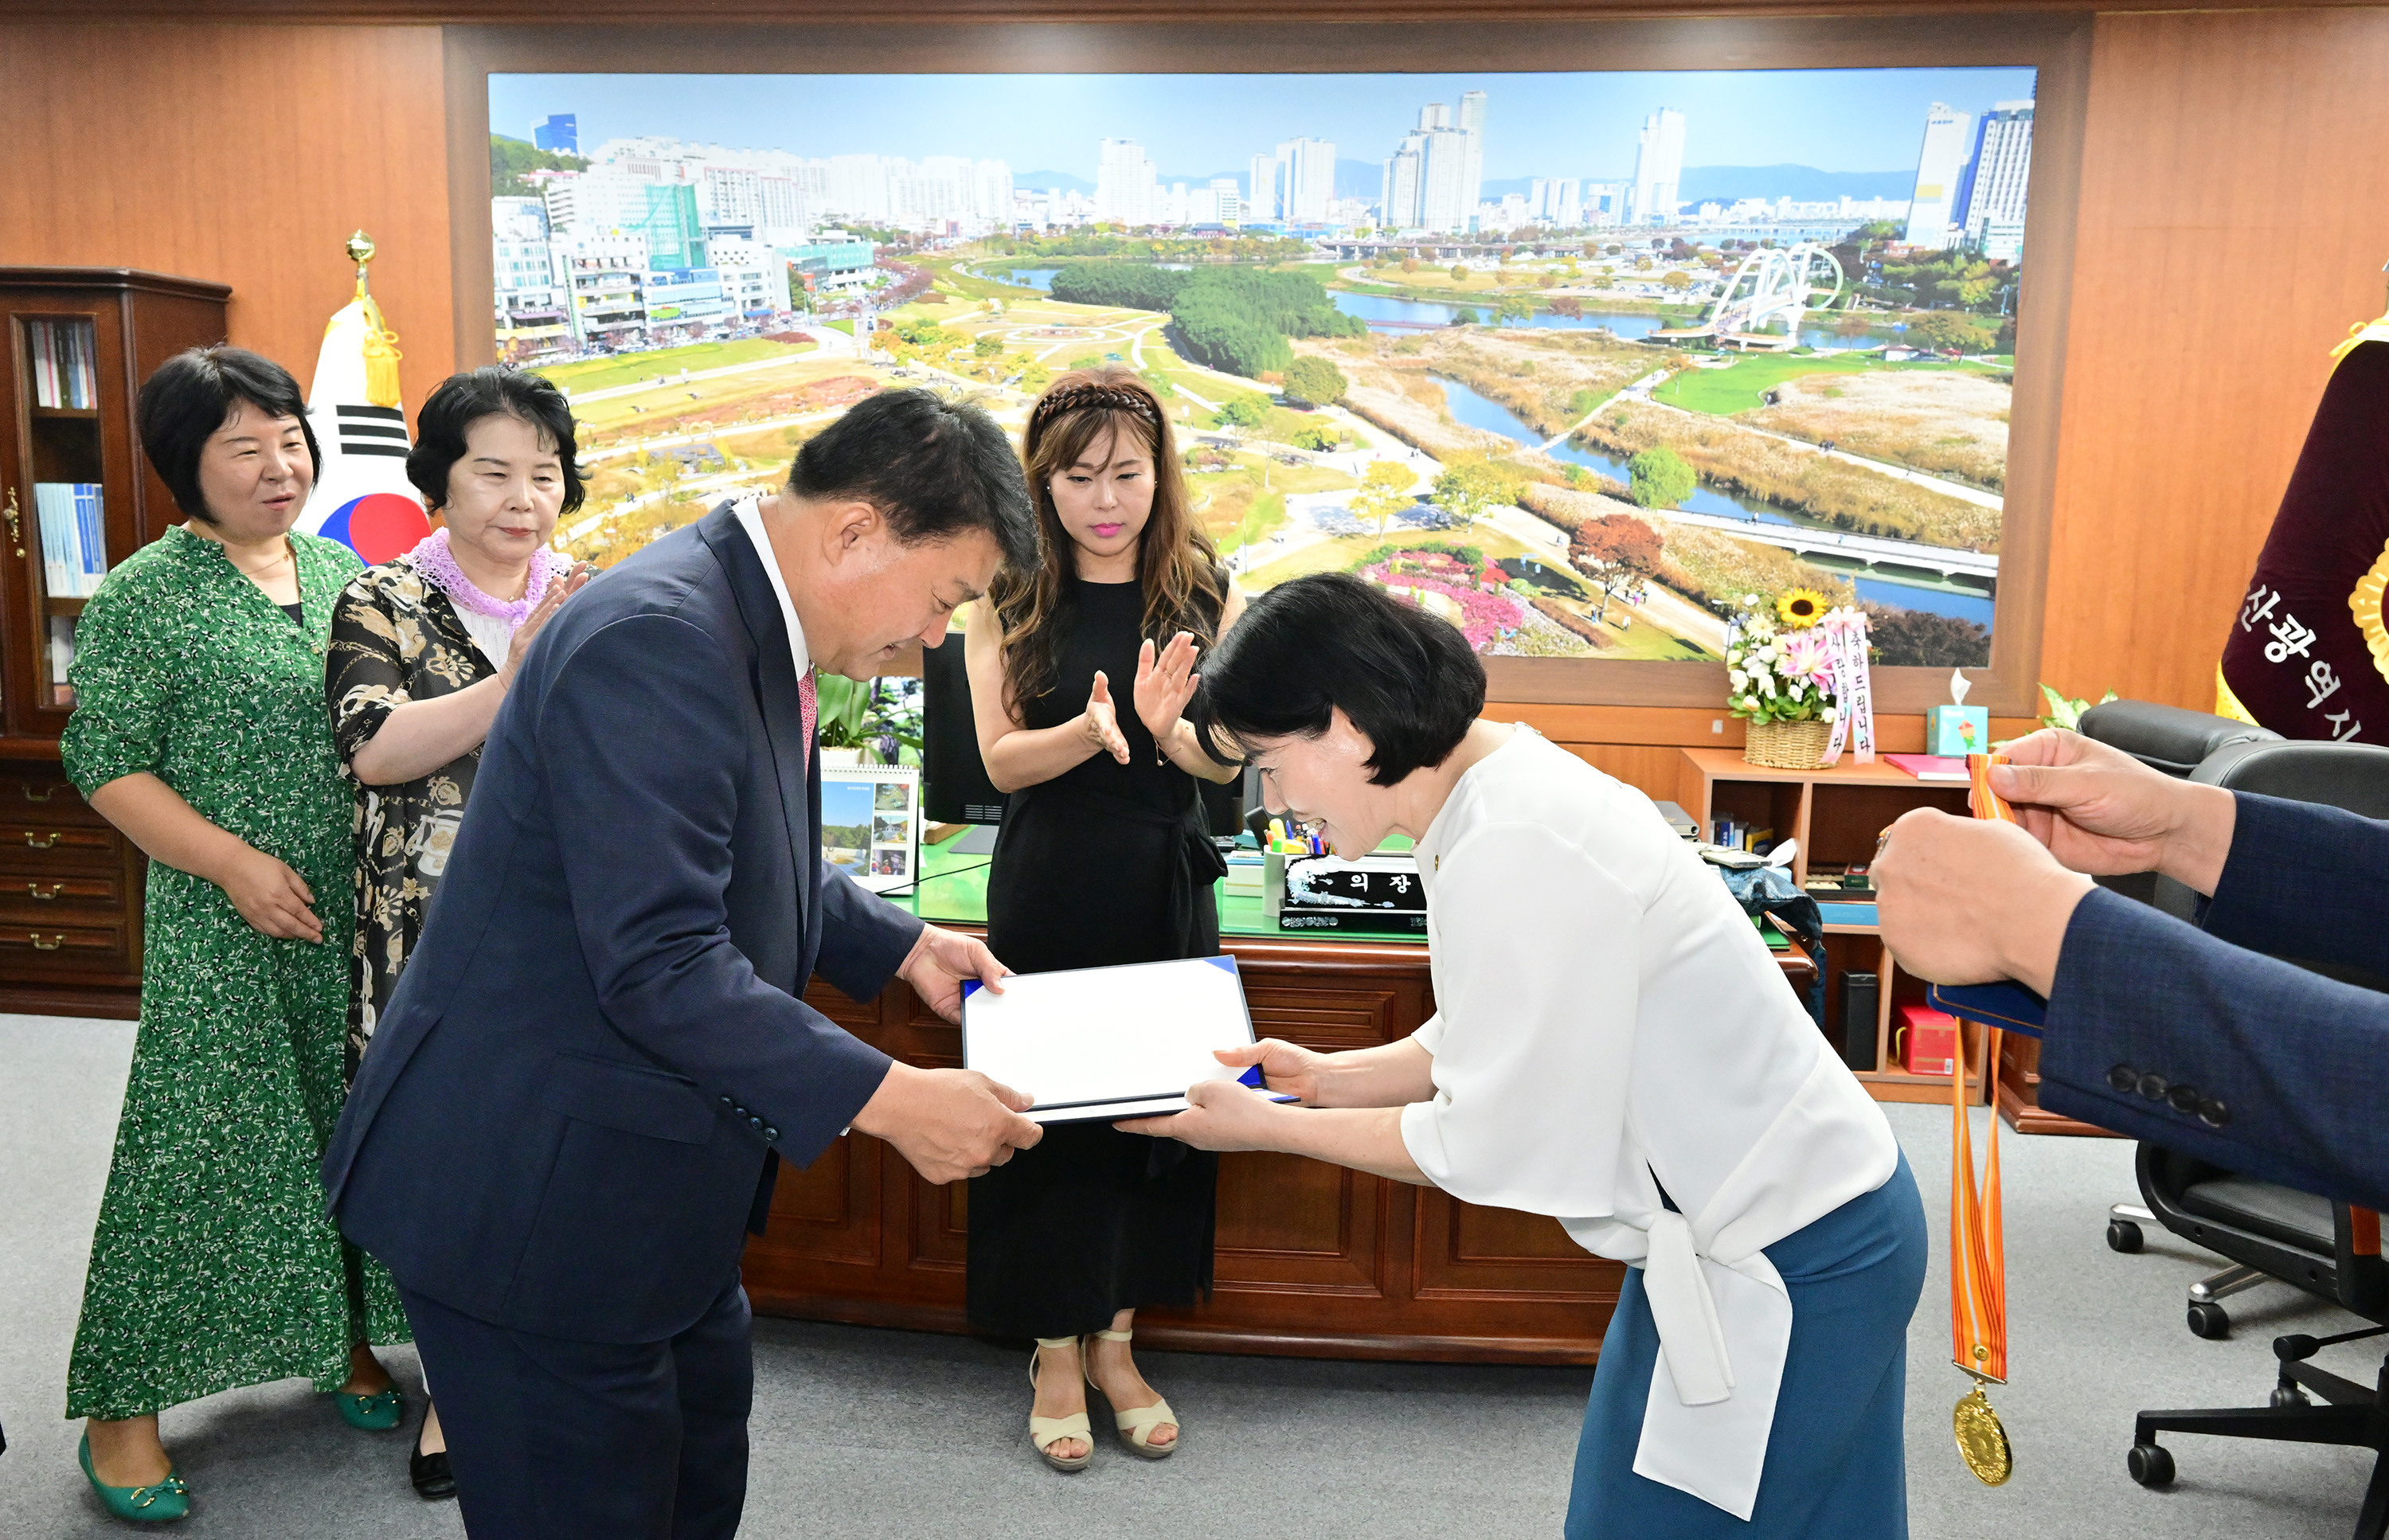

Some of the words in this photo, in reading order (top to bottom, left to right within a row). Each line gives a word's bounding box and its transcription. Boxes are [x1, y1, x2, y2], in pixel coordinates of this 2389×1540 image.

[1832, 632, 1849, 753] 사랑합니다
[1851, 631, 1871, 753] 축하드립니다
[2241, 584, 2362, 742] 산광역시
